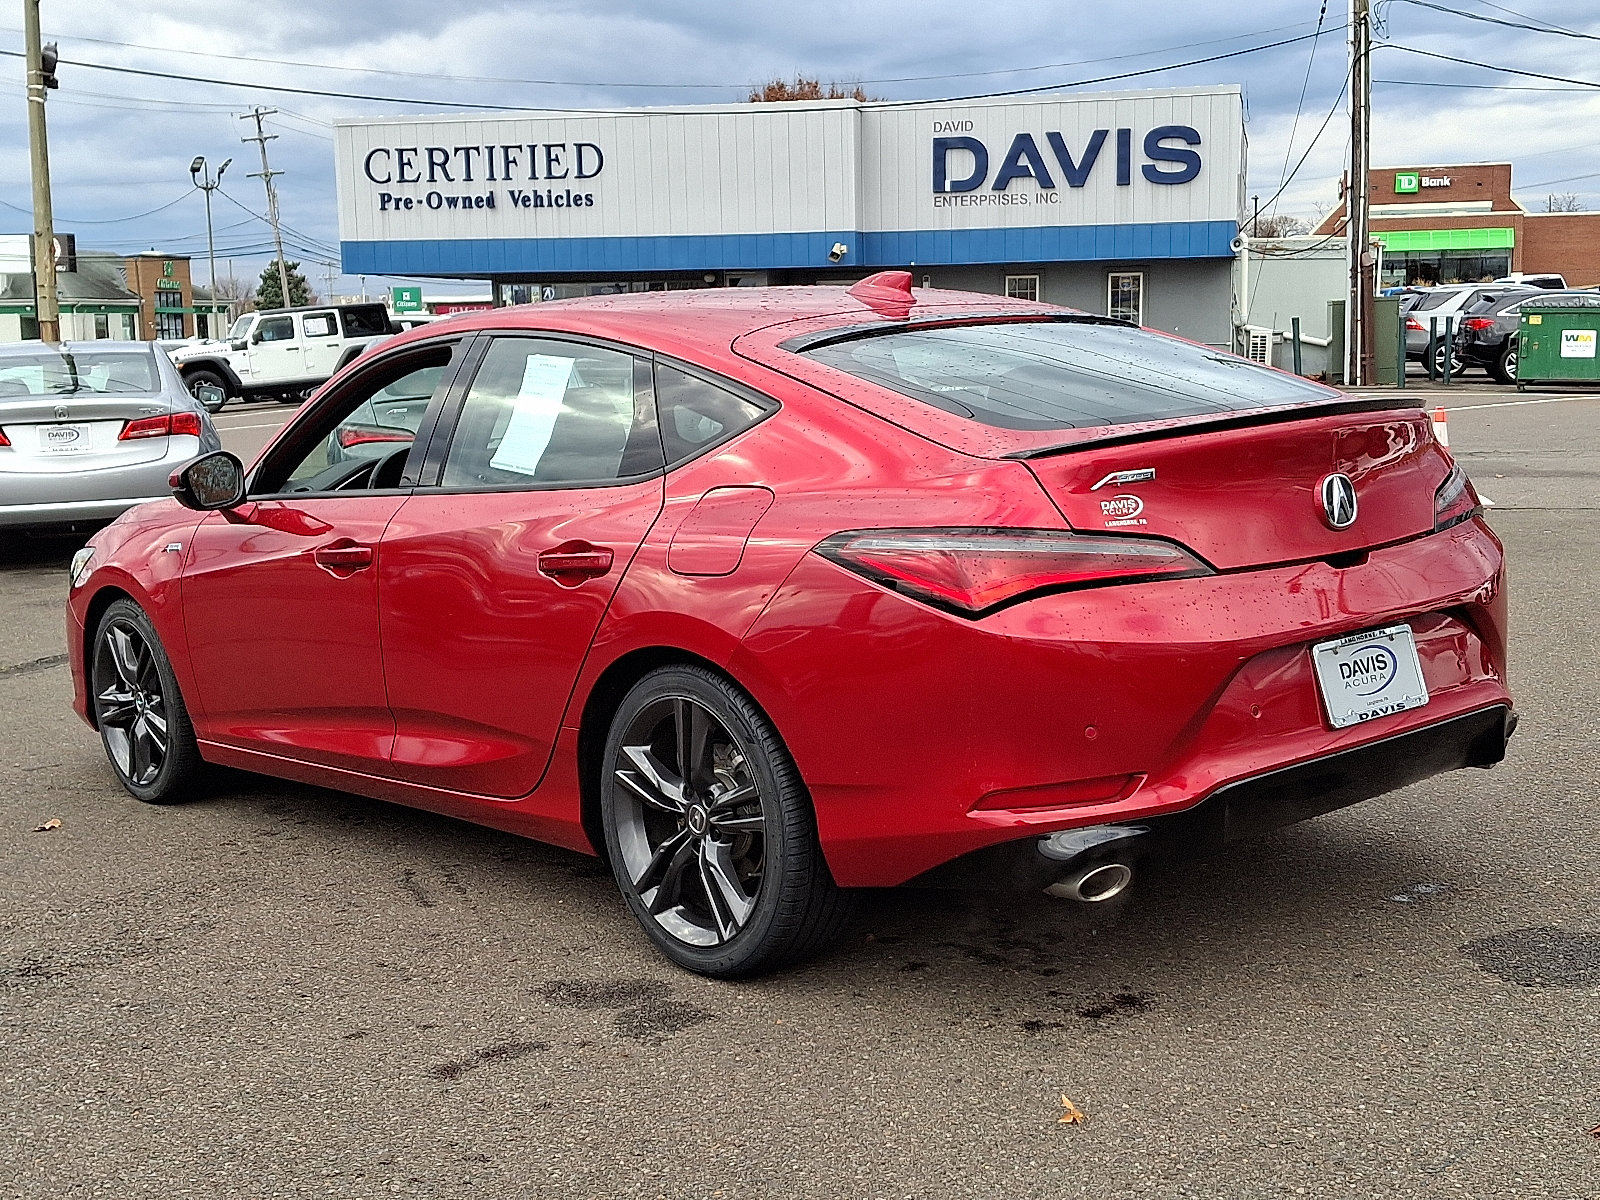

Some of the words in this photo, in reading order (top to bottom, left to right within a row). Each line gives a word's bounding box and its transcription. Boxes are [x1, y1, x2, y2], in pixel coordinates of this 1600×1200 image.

[933, 121, 974, 133] DAVID
[363, 143, 604, 184] CERTIFIED
[933, 125, 1201, 193] DAVIS
[1397, 175, 1417, 190] TD
[1421, 175, 1451, 187] Bank
[378, 190, 496, 211] Pre-Owned
[508, 189, 594, 208] Vehicles
[934, 194, 1031, 208] ENTERPRISES,
[1035, 192, 1062, 205] INC.
[396, 300, 418, 308] Citizens
[1564, 334, 1592, 342] WM
[48, 431, 75, 439] DAVIS
[1100, 498, 1136, 510] DAVIS
[1103, 507, 1135, 516] ACURA
[1339, 653, 1388, 680] DAVIS
[1344, 672, 1387, 690] ACURA
[1358, 702, 1406, 721] DAVIS
